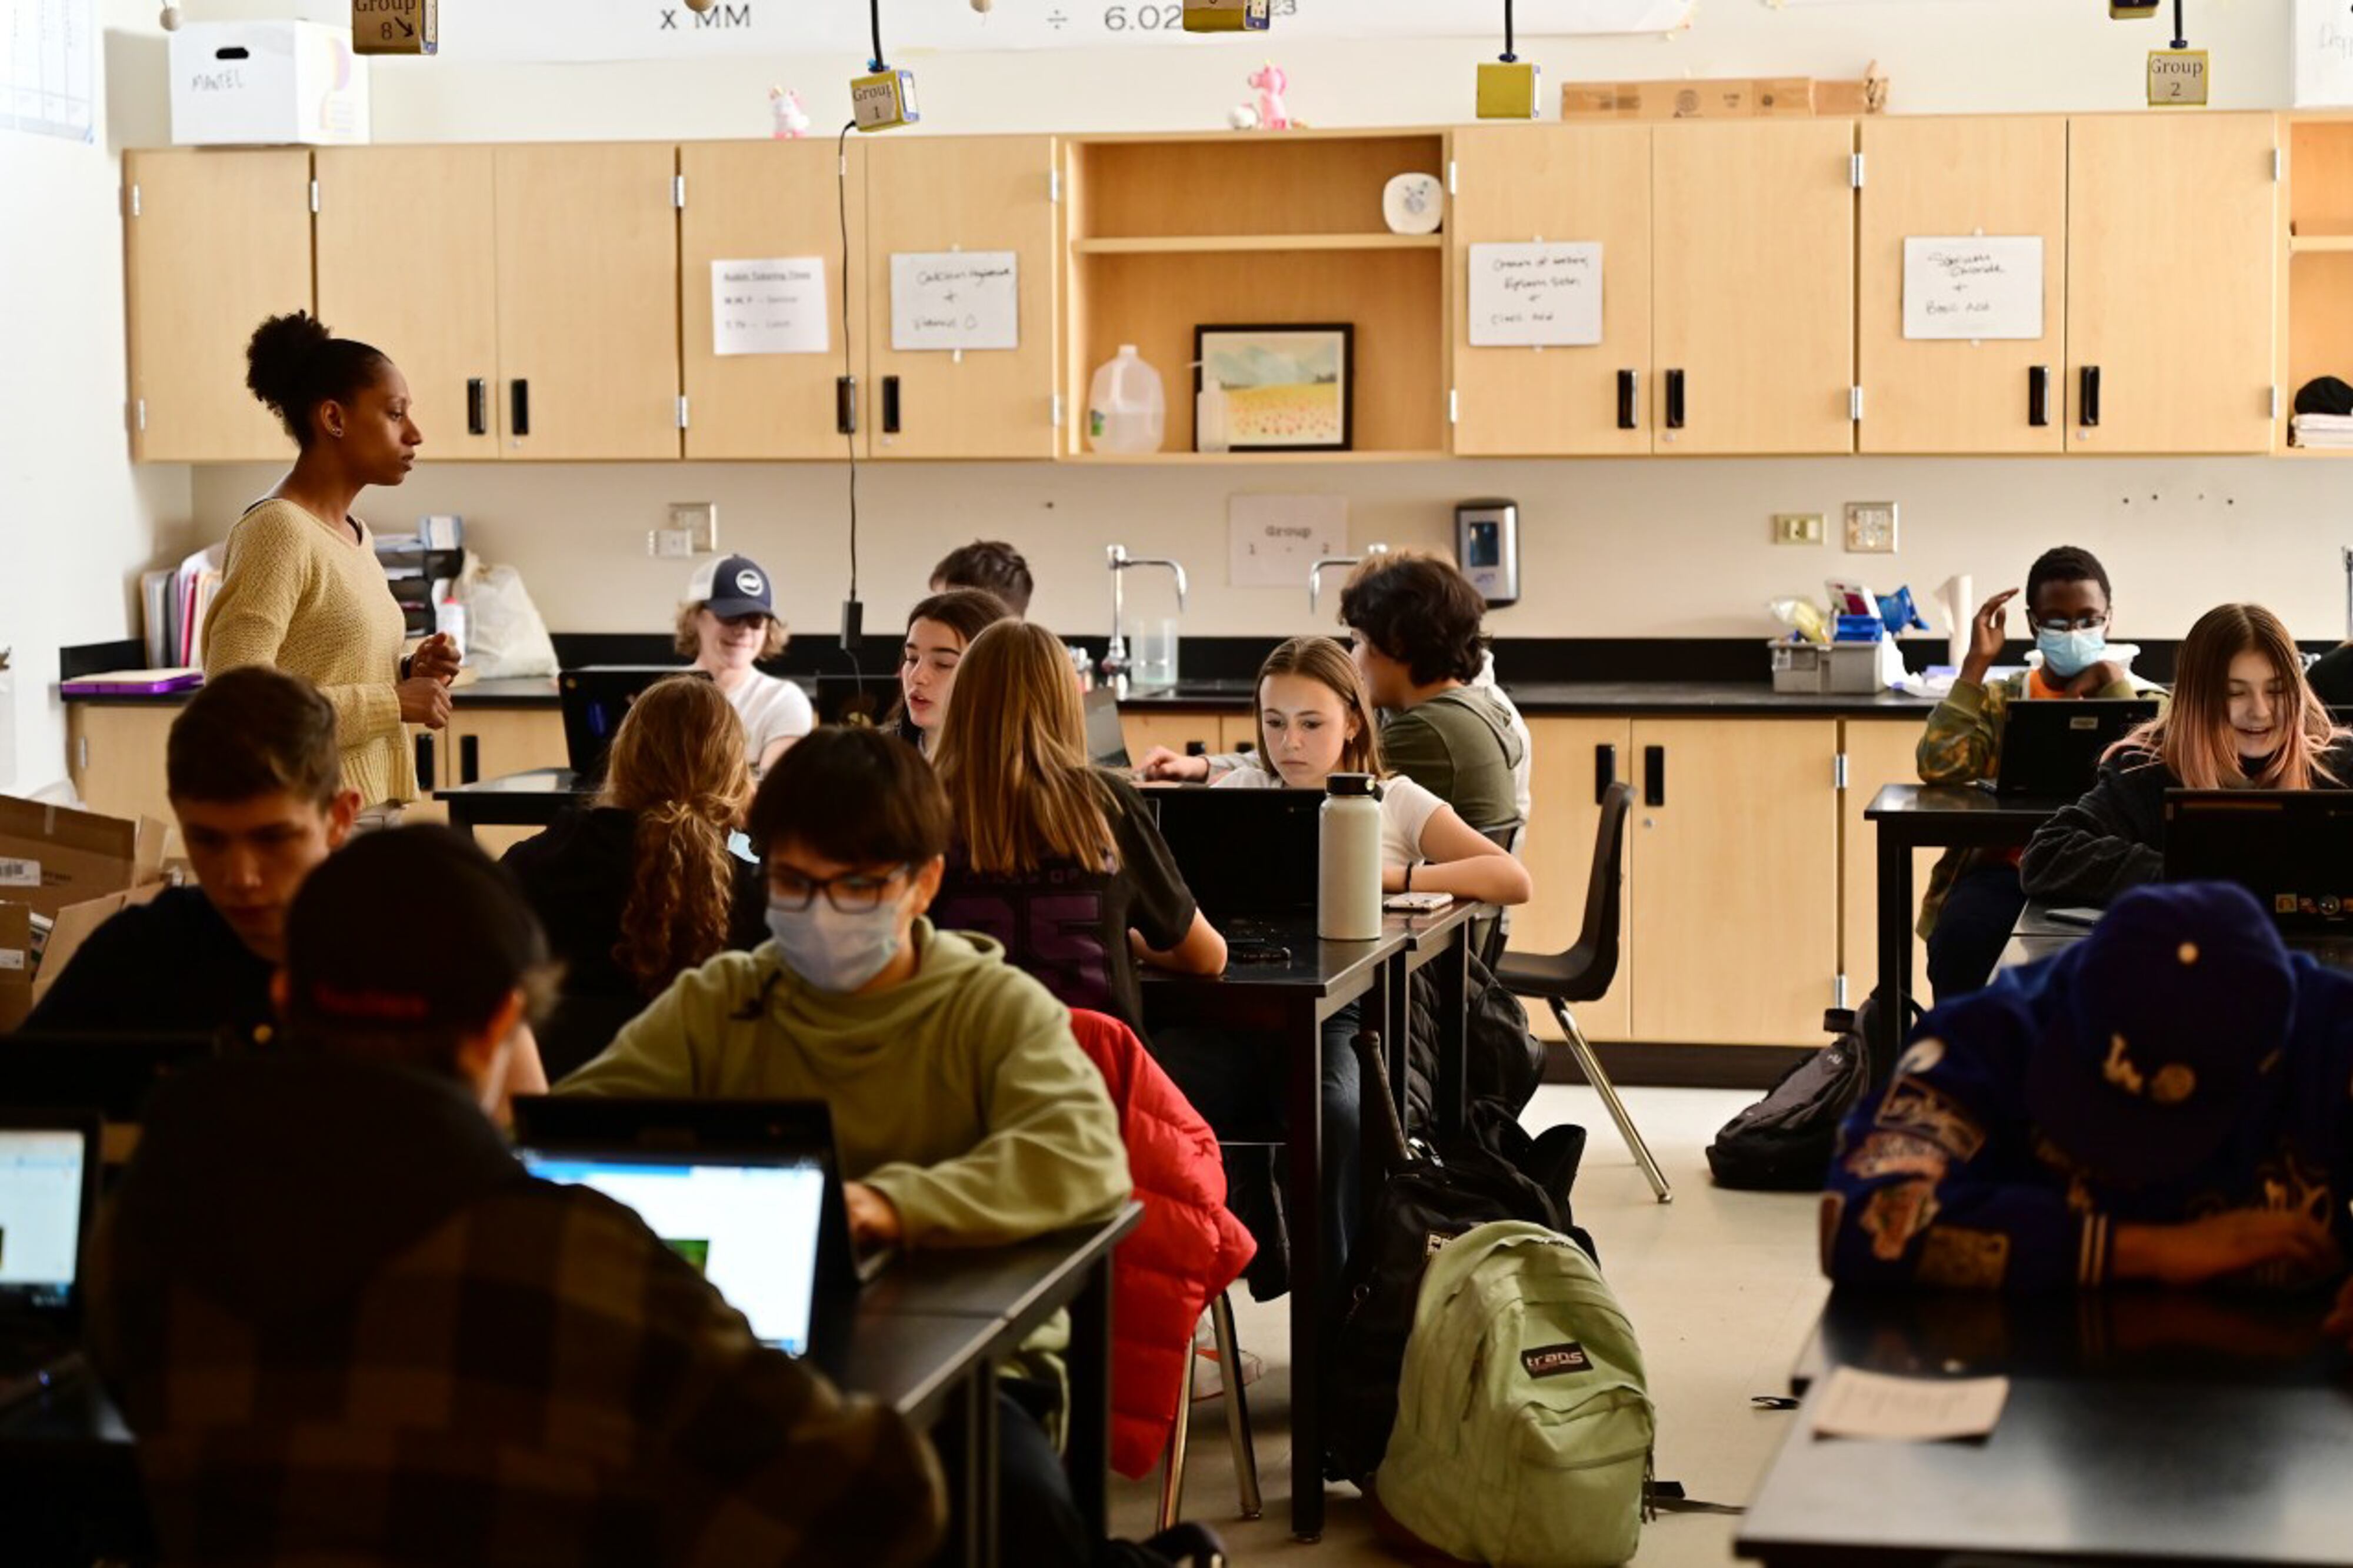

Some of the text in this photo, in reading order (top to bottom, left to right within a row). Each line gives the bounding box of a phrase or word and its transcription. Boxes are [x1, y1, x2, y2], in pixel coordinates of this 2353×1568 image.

[355, 0, 416, 15] Group
[1105, 5, 1182, 31] 6.02
[381, 22, 392, 40] 8
[2151, 58, 2203, 78] Group
[2170, 82, 2181, 96] 2
[873, 105, 880, 119] 1
[1265, 525, 1312, 539] Group
[1527, 1352, 1584, 1367] trans
